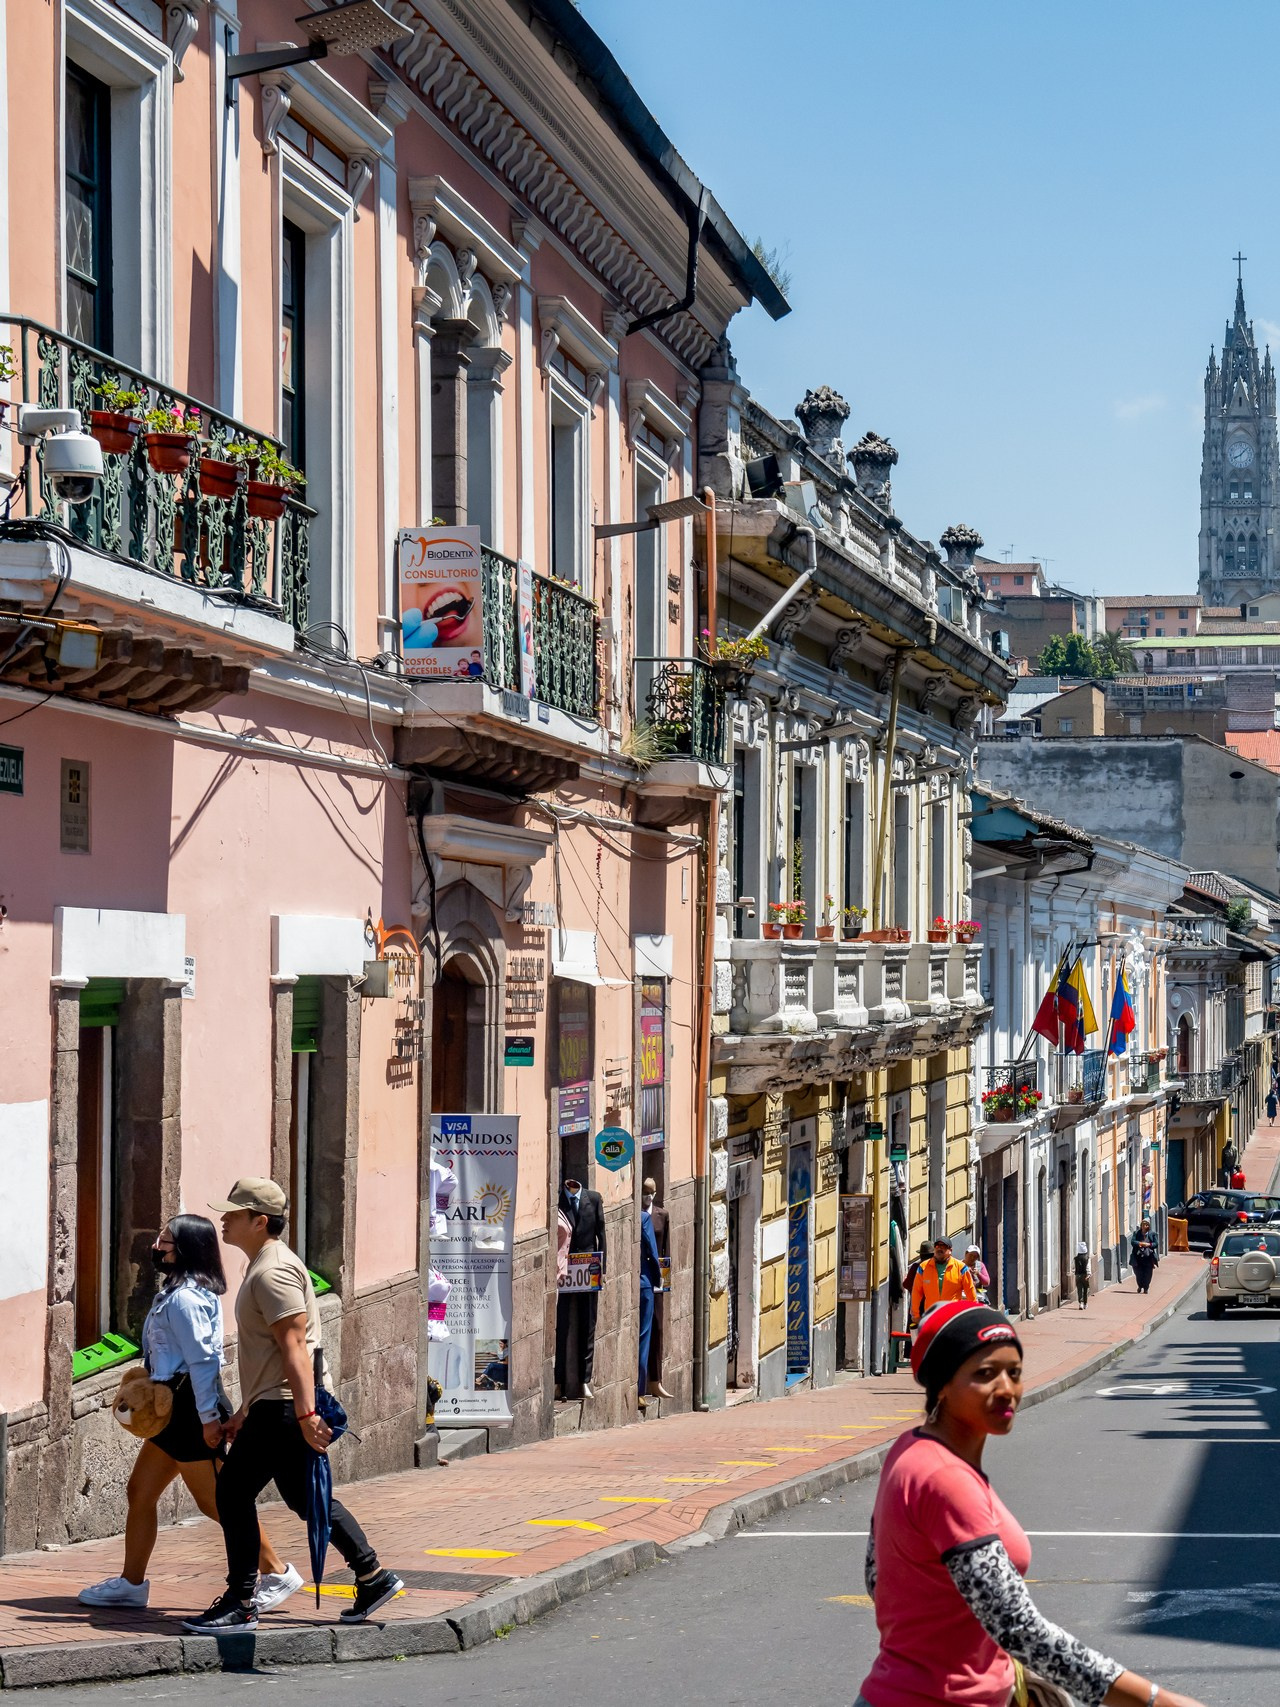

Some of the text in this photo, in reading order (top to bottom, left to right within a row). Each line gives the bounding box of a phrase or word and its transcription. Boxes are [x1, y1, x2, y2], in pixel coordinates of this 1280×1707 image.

[404, 568, 478, 579] CONSULTORIO
[405, 657, 437, 666] COSTOS
[405, 666, 452, 675] ACCESIBLES
[445, 1122, 469, 1131] VISA
[605, 1144, 620, 1153] alia
